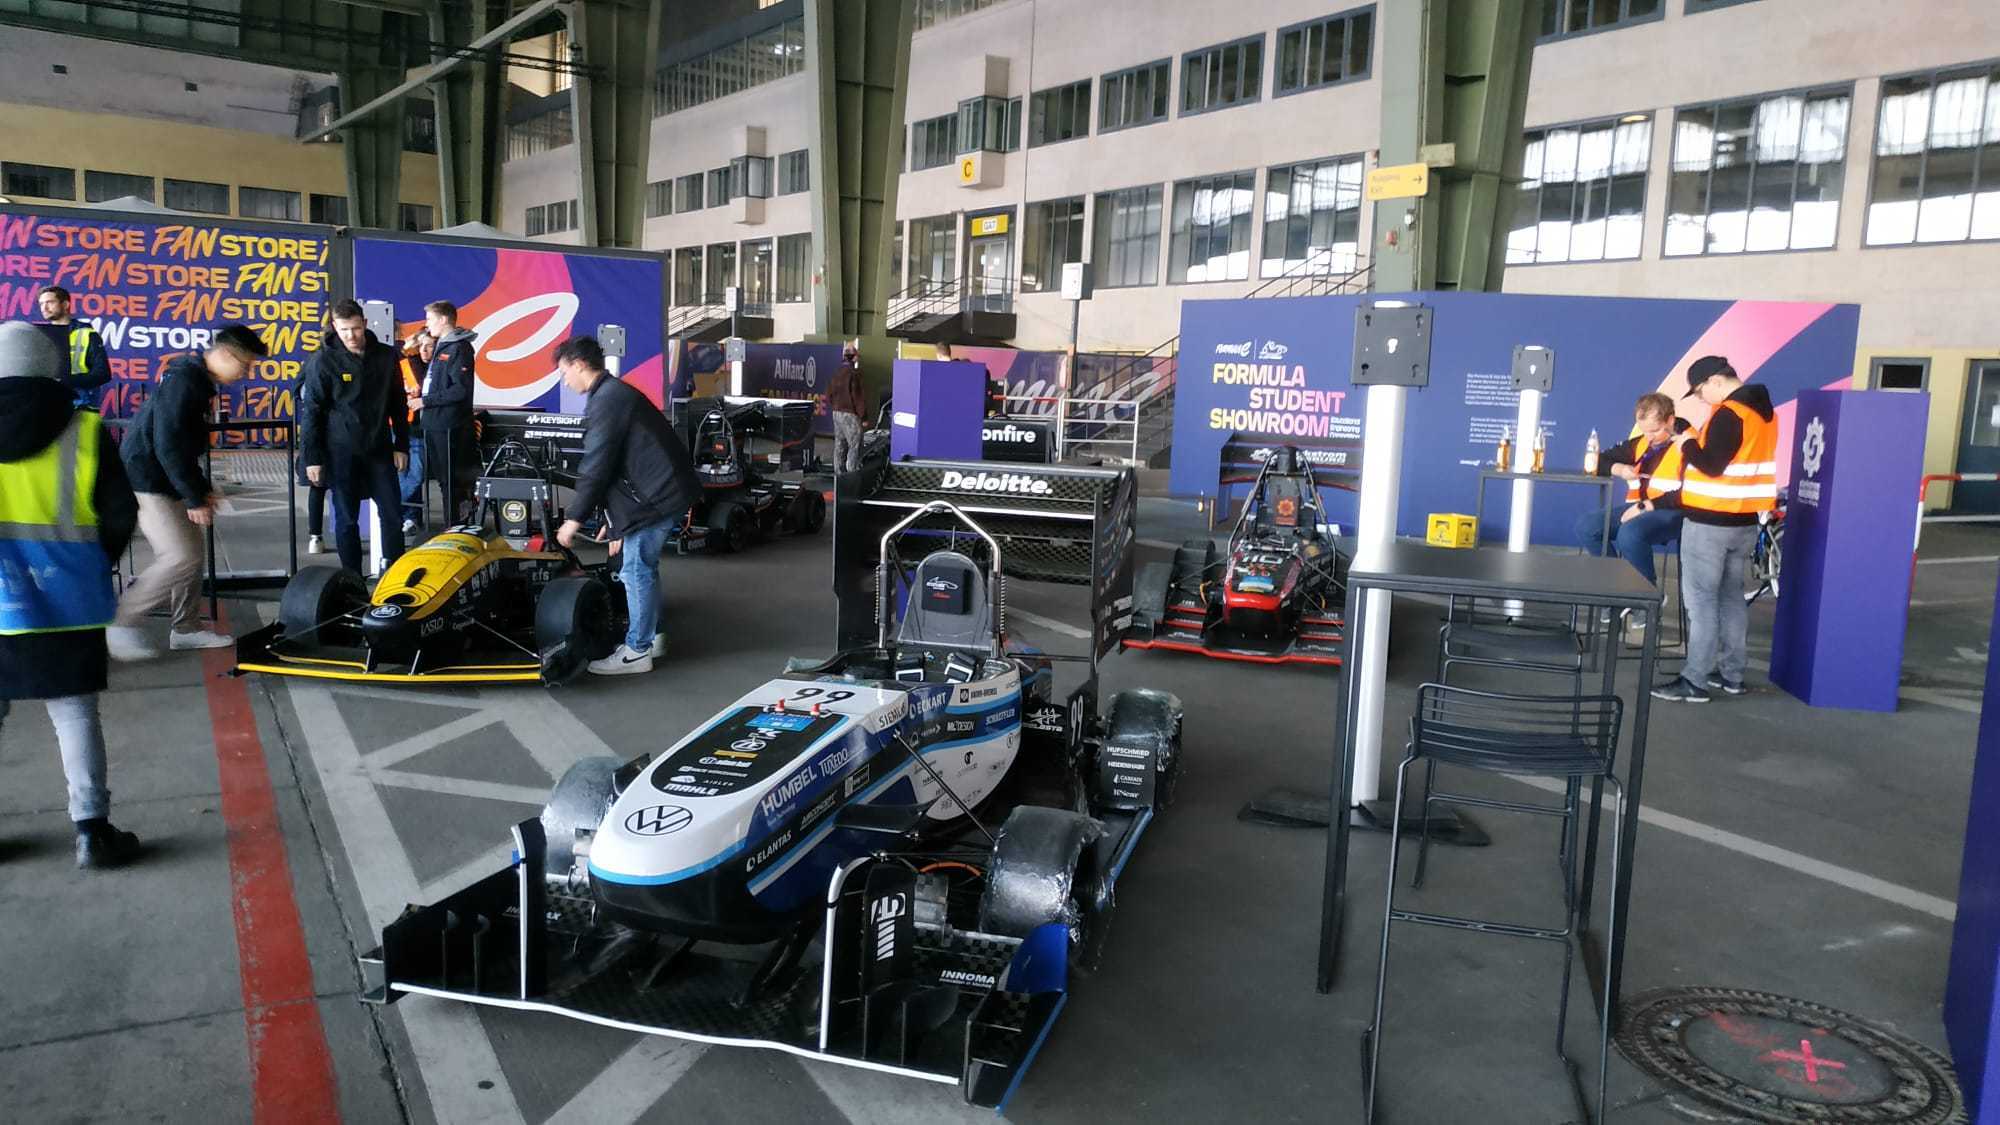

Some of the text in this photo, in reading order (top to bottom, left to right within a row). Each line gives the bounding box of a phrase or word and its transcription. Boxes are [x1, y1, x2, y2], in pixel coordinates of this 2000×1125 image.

[36, 224, 145, 252] STORE
[151, 226, 220, 261] FAN
[220, 235, 318, 261] STORE
[53, 254, 127, 290] FAN
[127, 263, 230, 290] STORE
[235, 262, 301, 297] FAN
[67, 293, 148, 317] TORE
[153, 289, 223, 325] FAN
[222, 298, 320, 322] STORE
[129, 326, 217, 350] STOR
[774, 358, 805, 380] Allianz
[1213, 362, 1306, 387] FORMULA
[1249, 387, 1346, 415] STUDENT
[540, 416, 582, 425] KEYSIGHT
[1209, 407, 1330, 438] SHOWROOM
[941, 471, 1053, 495] Deloitte.
[787, 687, 856, 704] 99
[917, 691, 947, 715] ECKART
[1071, 695, 1084, 746] 99
[663, 783, 720, 796] MAHLE
[761, 765, 818, 817] HUMBEL
[818, 748, 849, 777] TUXEDO
[757, 829, 793, 865] ELANTAS
[940, 969, 995, 985] INNOMA
